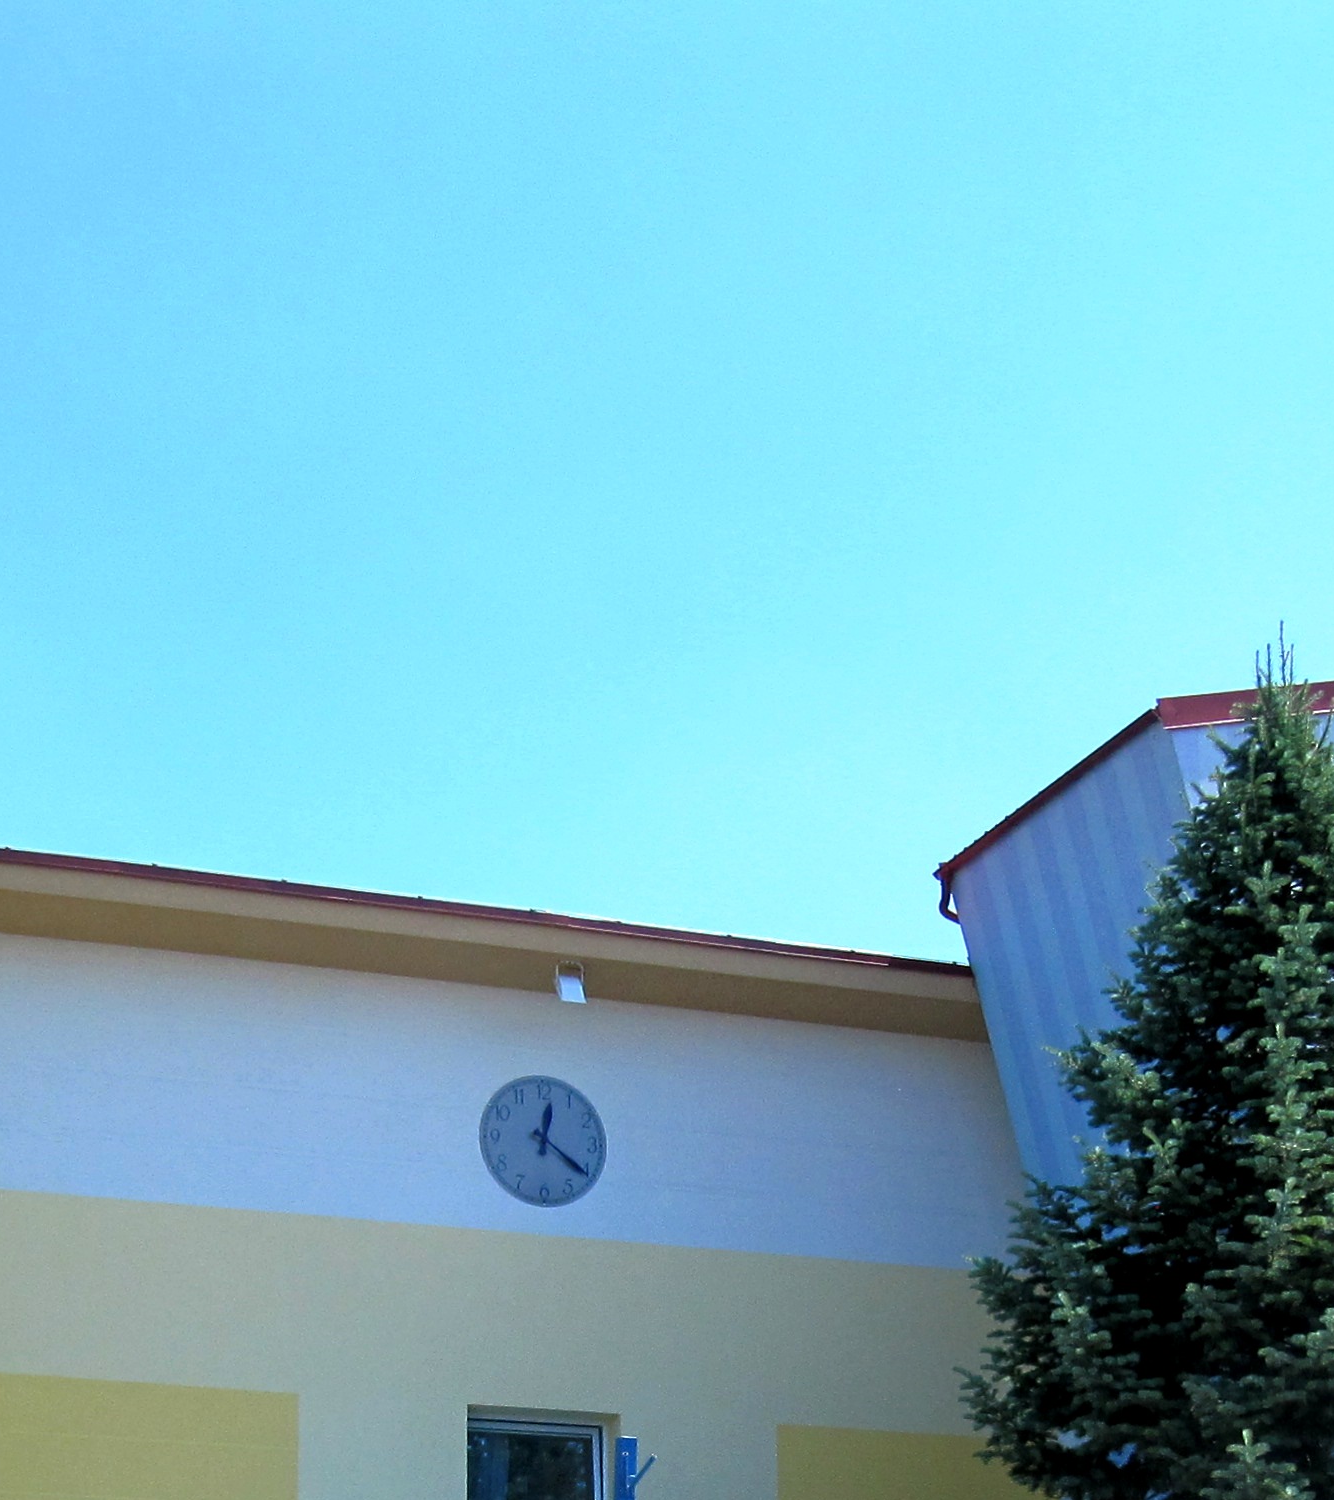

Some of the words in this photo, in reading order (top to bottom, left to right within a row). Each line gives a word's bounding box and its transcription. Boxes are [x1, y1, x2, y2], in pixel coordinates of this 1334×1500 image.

[513, 1088, 525, 1105] 11
[537, 1084, 552, 1100] 12
[495, 1104, 511, 1121] 10
[489, 1129, 501, 1144] 9
[587, 1136, 598, 1154] 3
